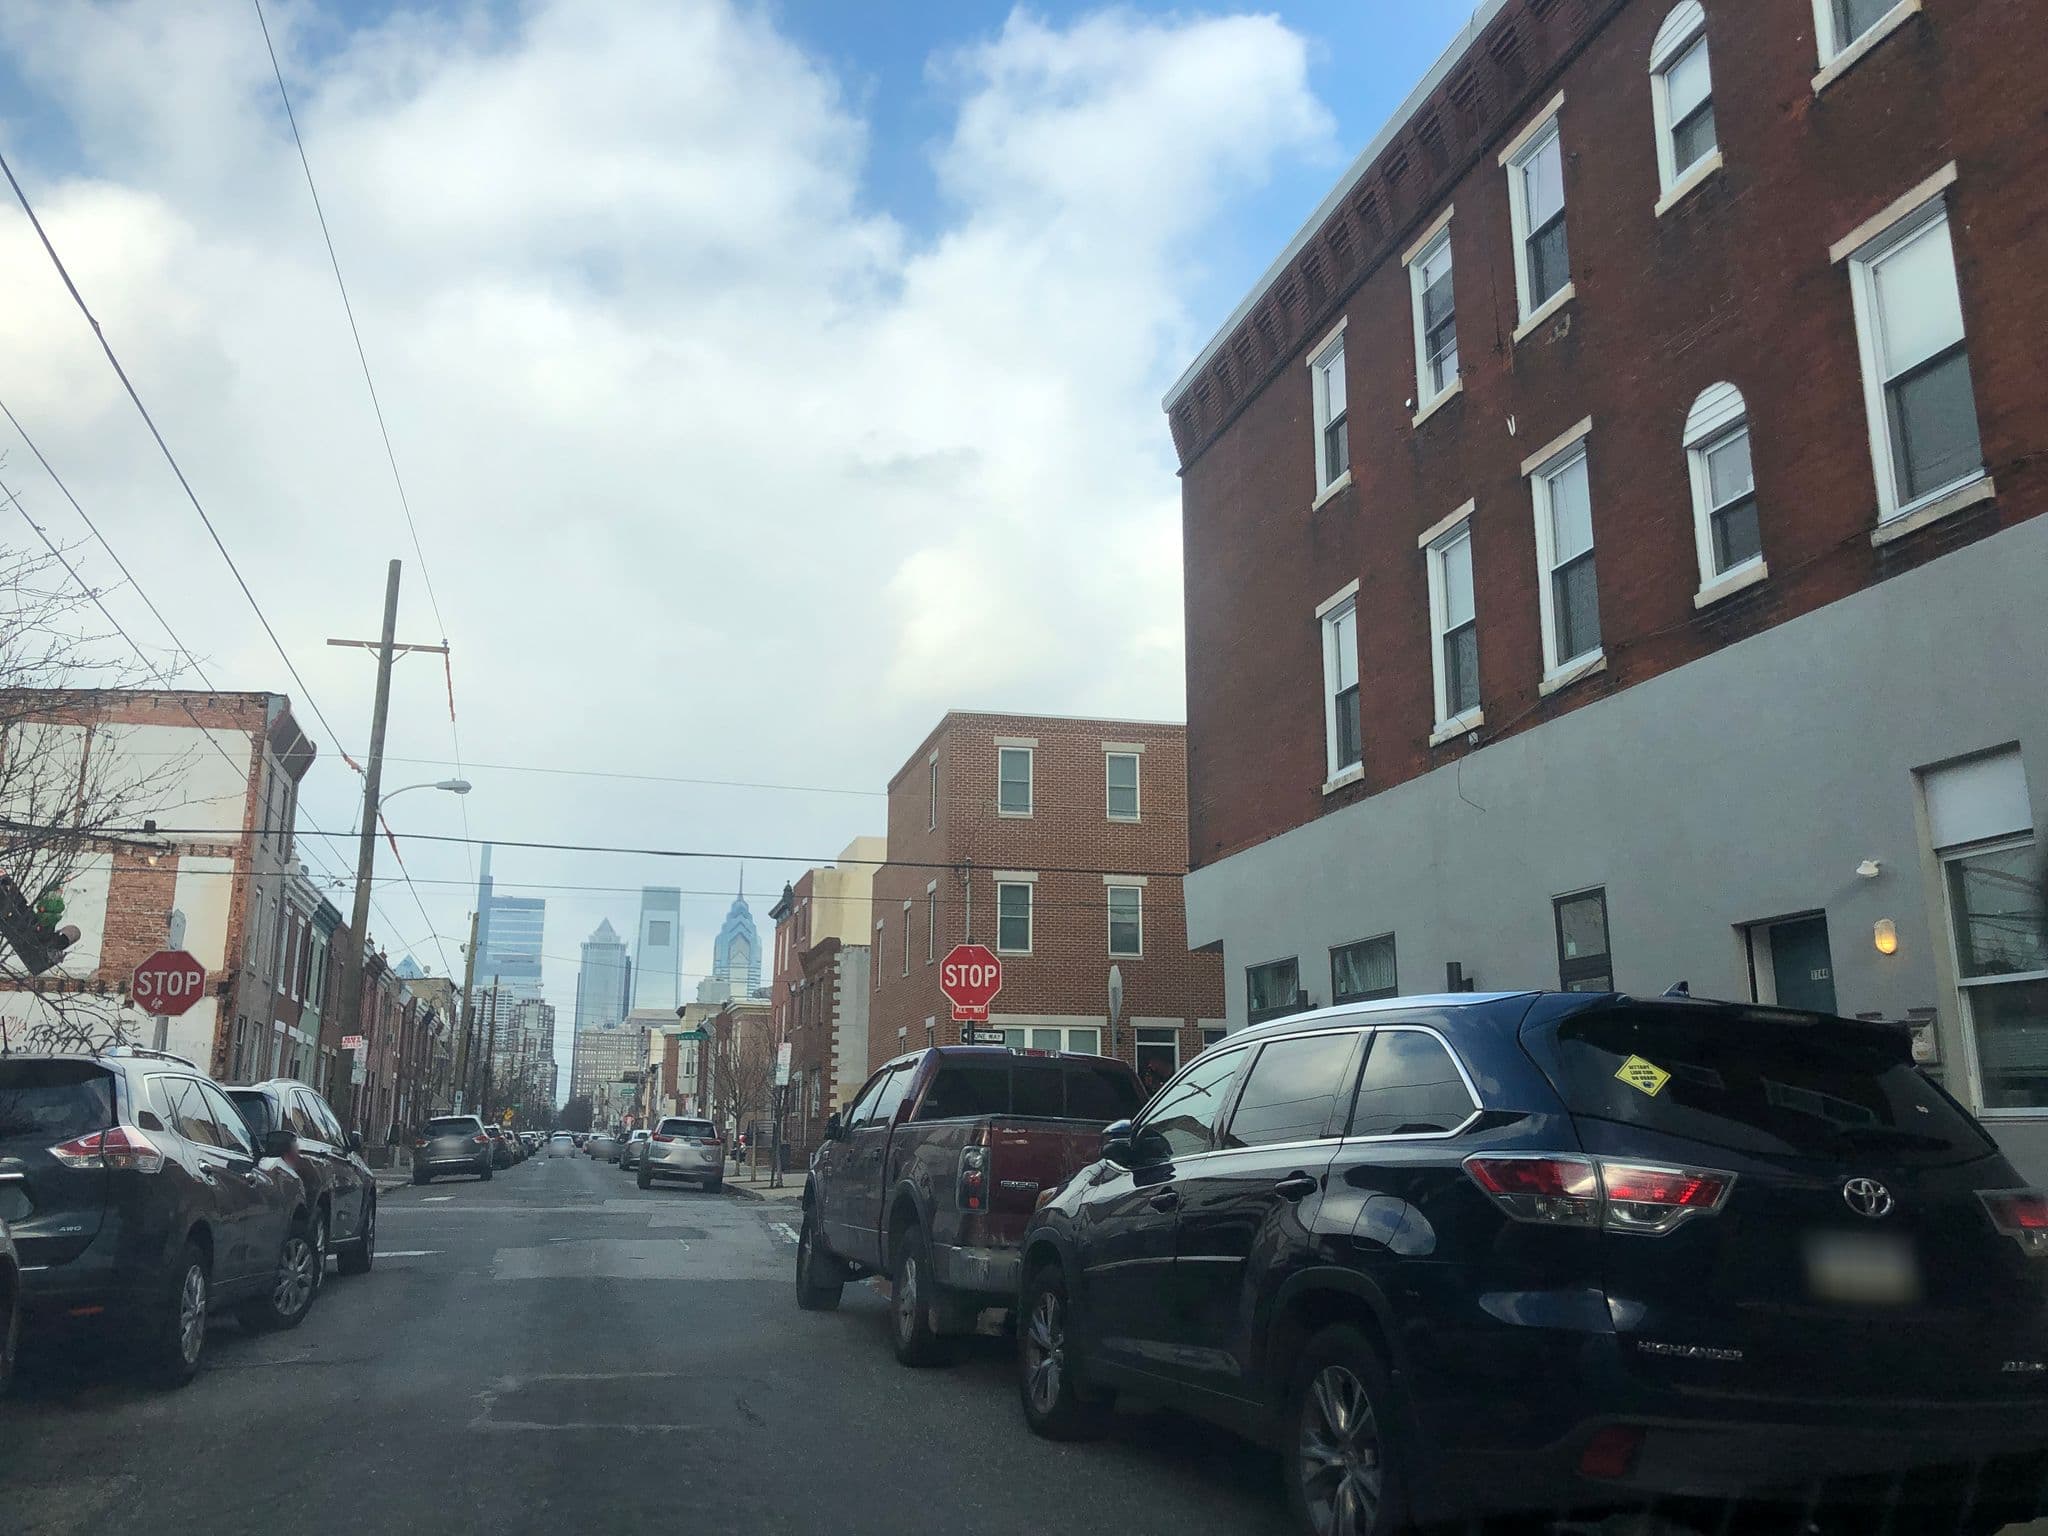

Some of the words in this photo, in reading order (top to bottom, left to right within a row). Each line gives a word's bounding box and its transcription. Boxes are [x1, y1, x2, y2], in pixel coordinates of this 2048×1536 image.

[137, 971, 201, 996] STOP
[945, 964, 997, 987] STOP
[974, 1032, 986, 1040] ONE
